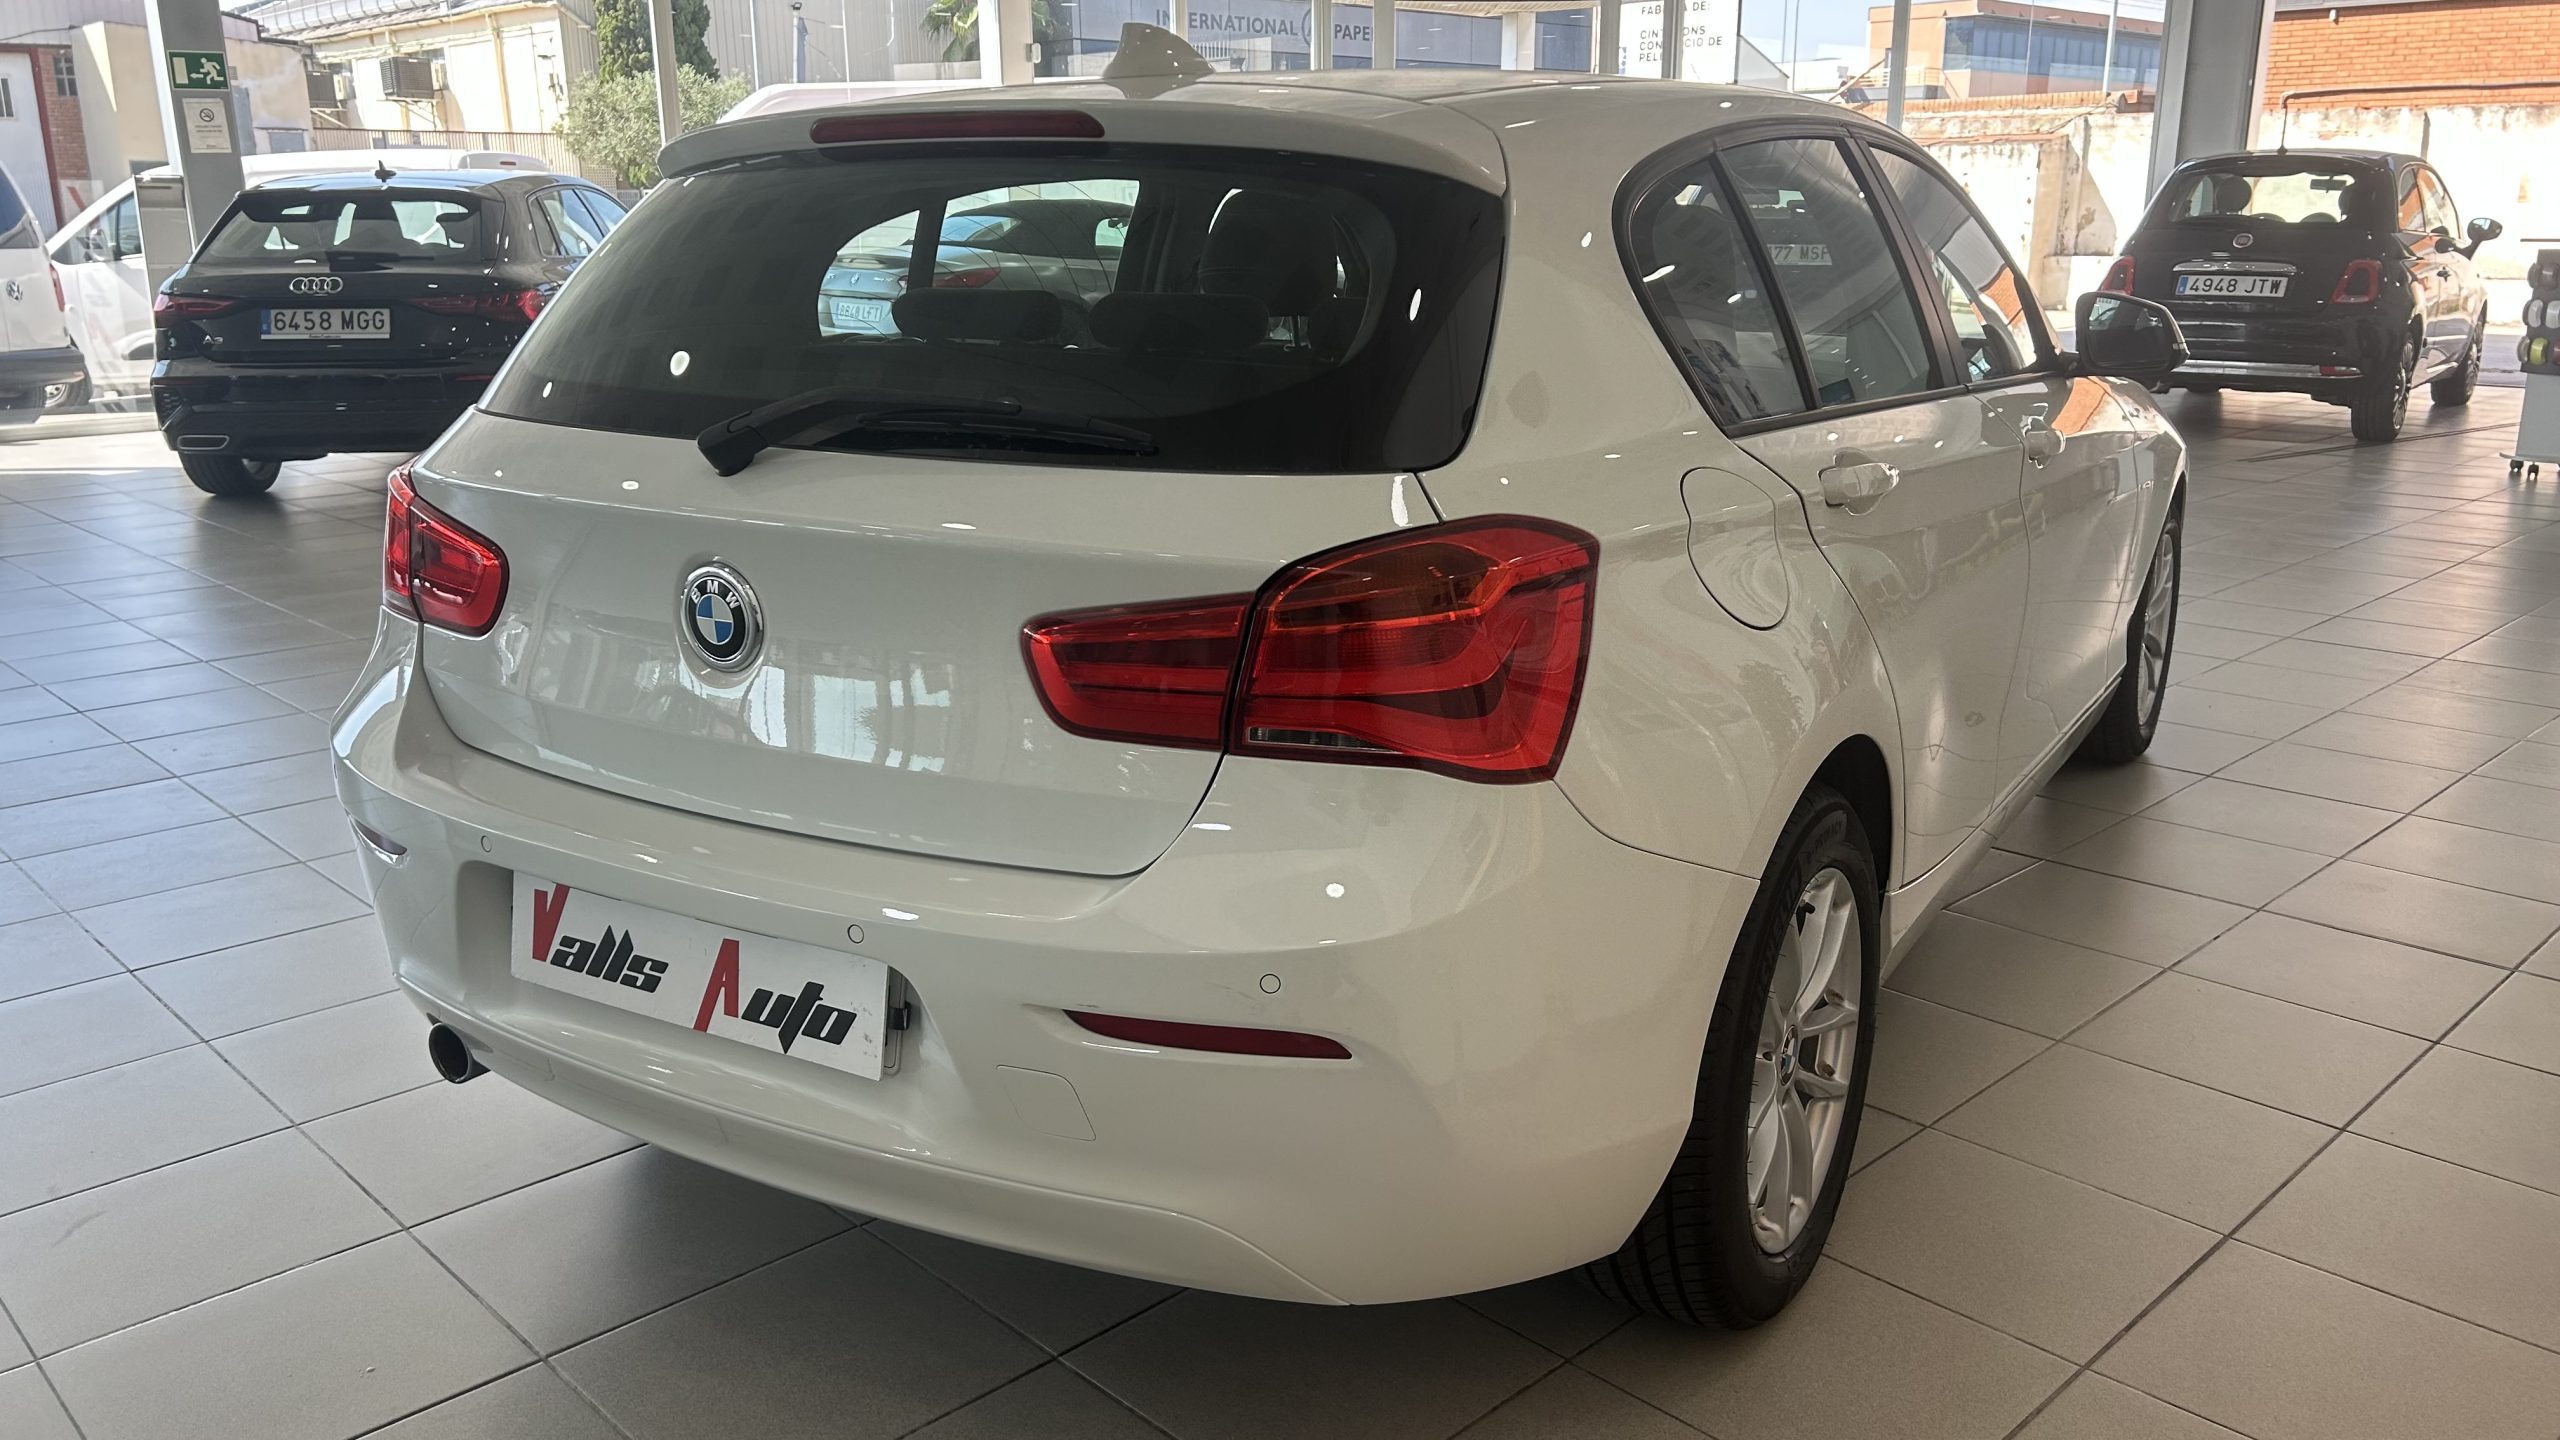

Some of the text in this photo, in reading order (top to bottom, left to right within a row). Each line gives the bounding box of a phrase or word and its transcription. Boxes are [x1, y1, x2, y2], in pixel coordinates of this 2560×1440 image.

[1156, 9, 1374, 42] INERNATIONAL PAPE
[1640, 25, 1706, 39] CINONS
[1639, 36, 1723, 51] CONCIO DE
[2189, 278, 2237, 293] 4948
[2244, 278, 2282, 294] JTW
[273, 311, 385, 331] 6458 MGG
[202, 335, 224, 345] A3
[690, 580, 740, 609] BMW
[532, 883, 857, 1055] Valls Auto
